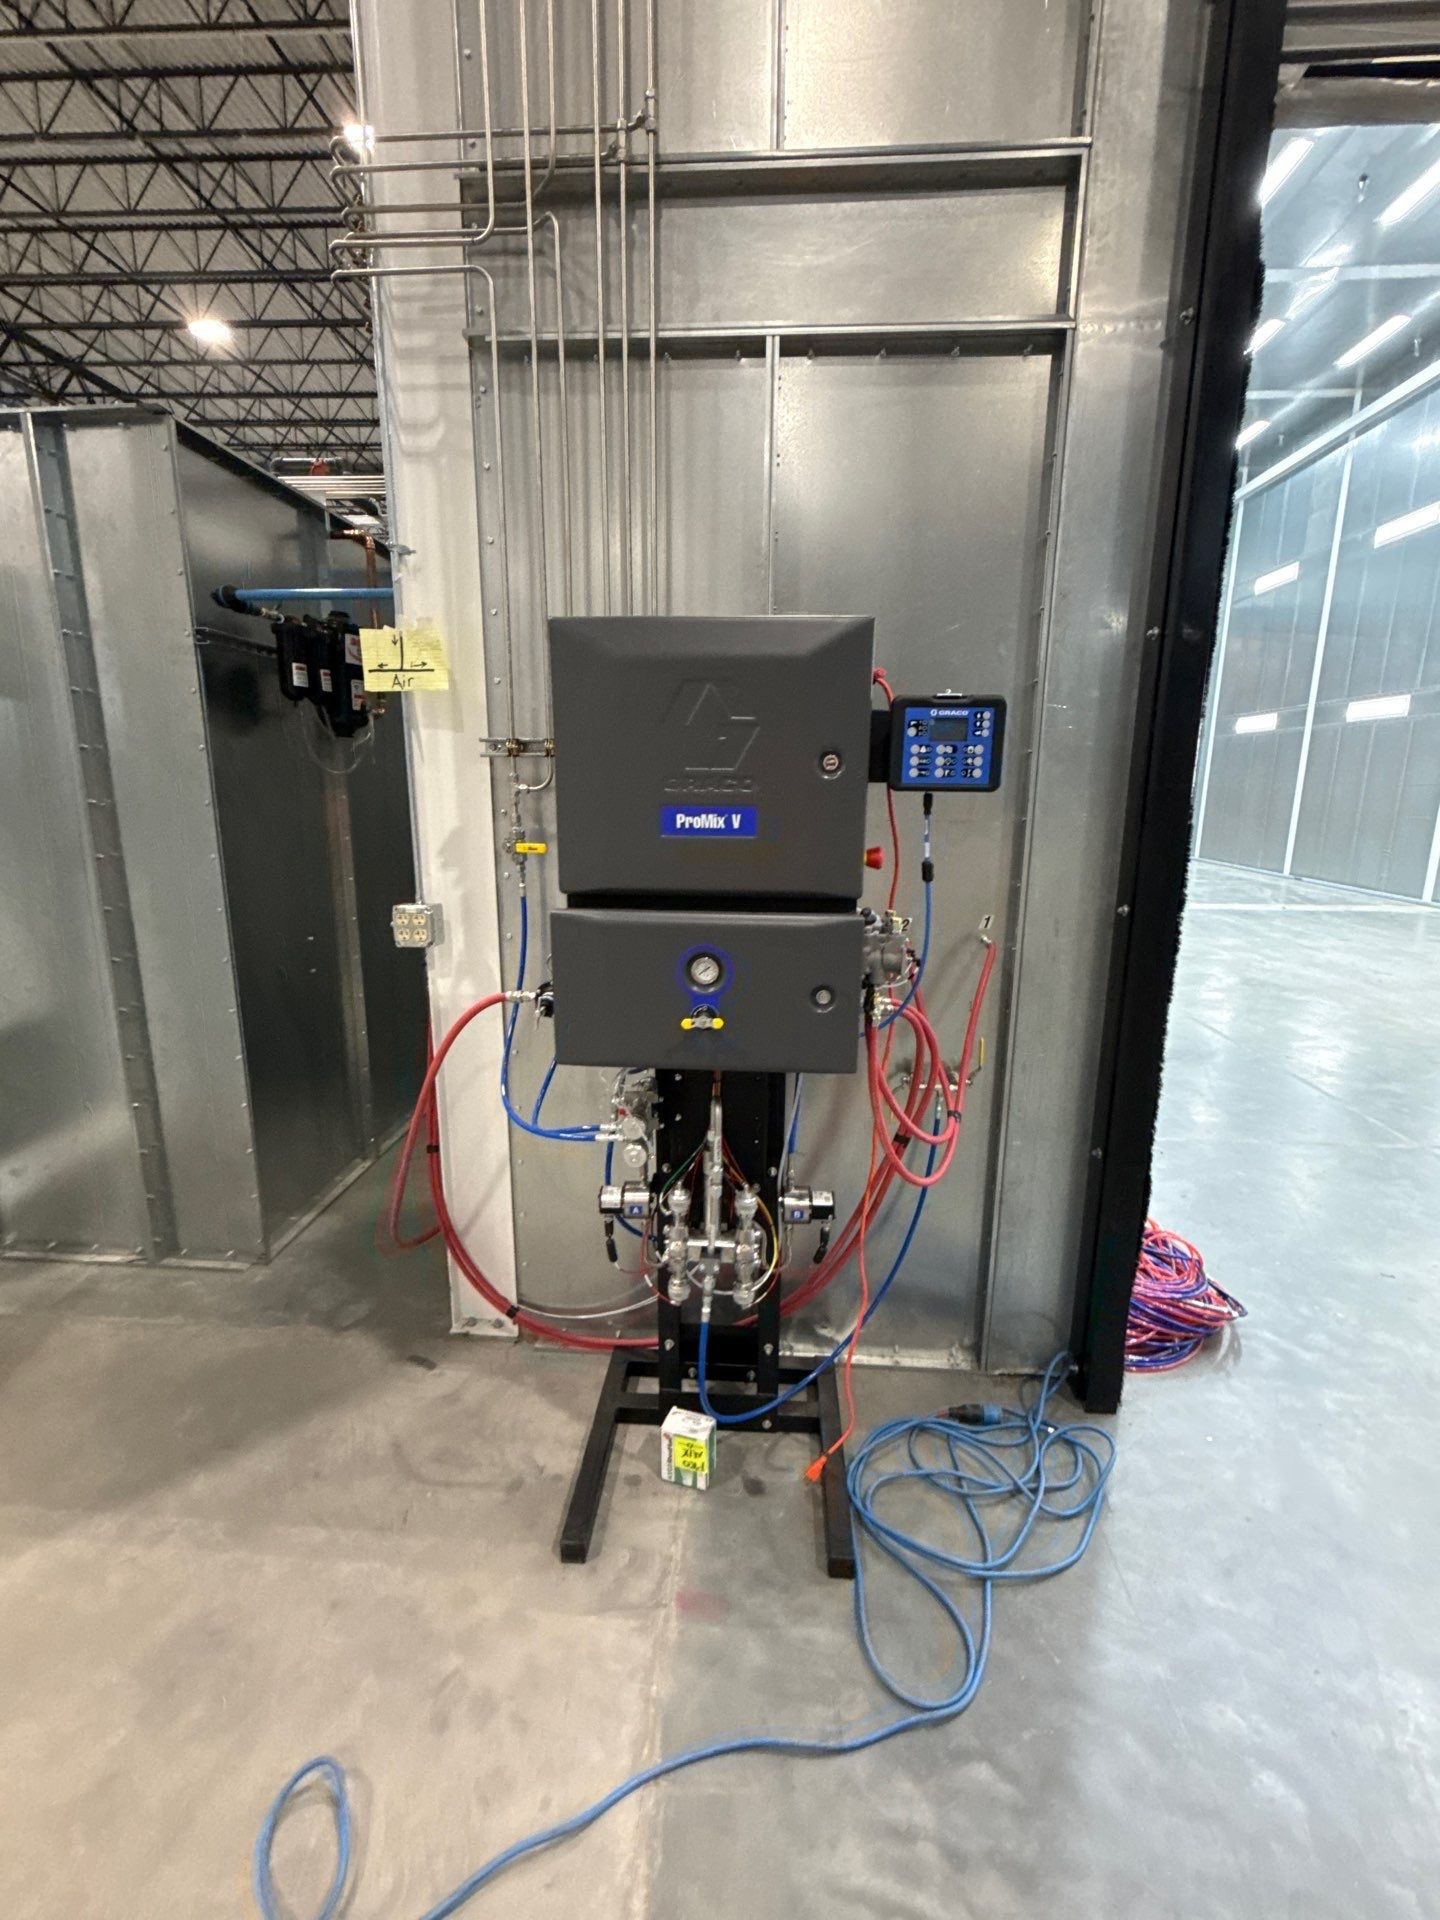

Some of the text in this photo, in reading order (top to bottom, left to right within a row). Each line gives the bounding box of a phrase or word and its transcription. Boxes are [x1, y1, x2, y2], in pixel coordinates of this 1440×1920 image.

[391, 674, 415, 690] Air
[675, 813, 741, 829] ProMix V
[901, 918, 911, 932] 2
[984, 916, 992, 929] 1
[632, 1206, 640, 1215] A
